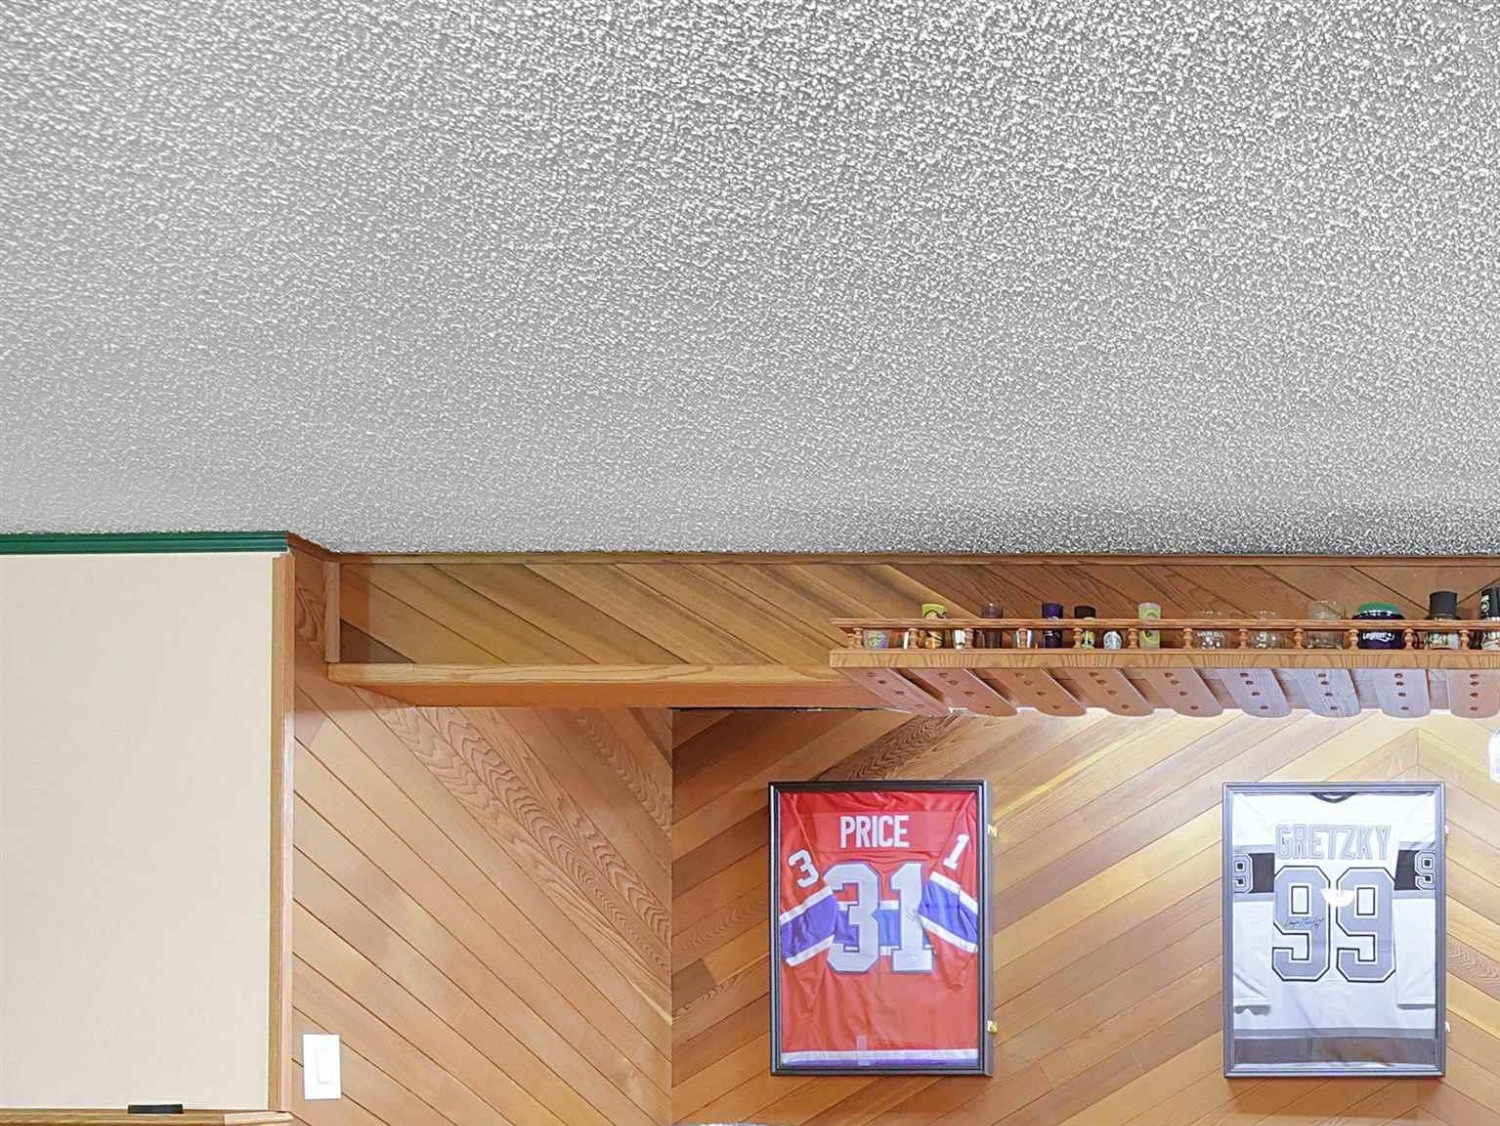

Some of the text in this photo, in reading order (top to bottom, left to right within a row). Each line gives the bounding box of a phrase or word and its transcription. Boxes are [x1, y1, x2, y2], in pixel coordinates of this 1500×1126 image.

[840, 814, 910, 848] PRICE
[1275, 824, 1392, 861] GRETZKY
[788, 849, 820, 888] 3
[942, 833, 970, 871] 1
[821, 860, 935, 974] 31
[1272, 865, 1396, 983] 99
